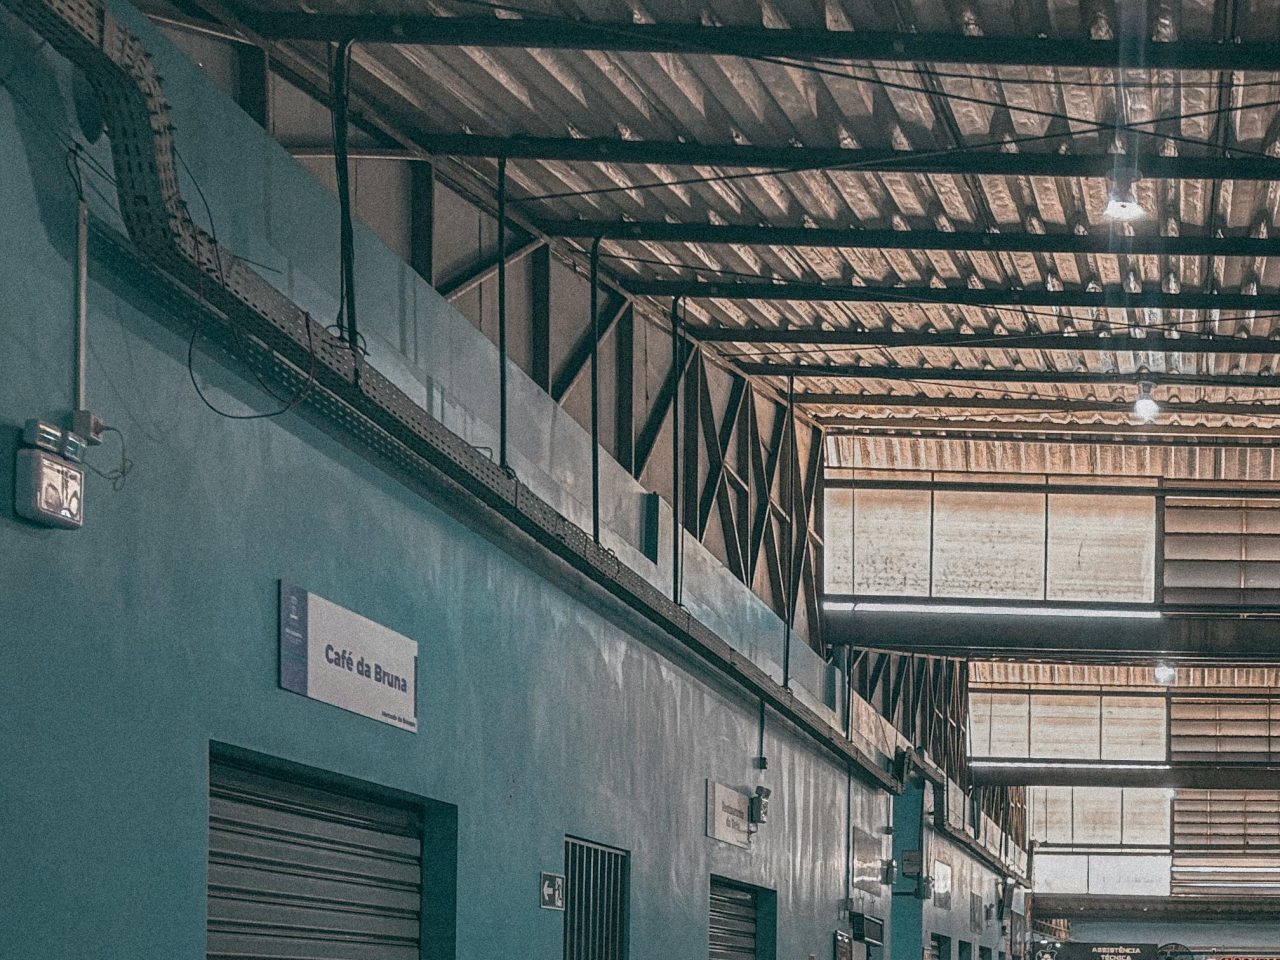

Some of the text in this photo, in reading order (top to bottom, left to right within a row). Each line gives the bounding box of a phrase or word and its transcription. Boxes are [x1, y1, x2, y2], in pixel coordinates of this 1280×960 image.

[325, 644, 408, 693] Café da Bruna
[1092, 946, 1142, 954] ASSISTÊNCIA
